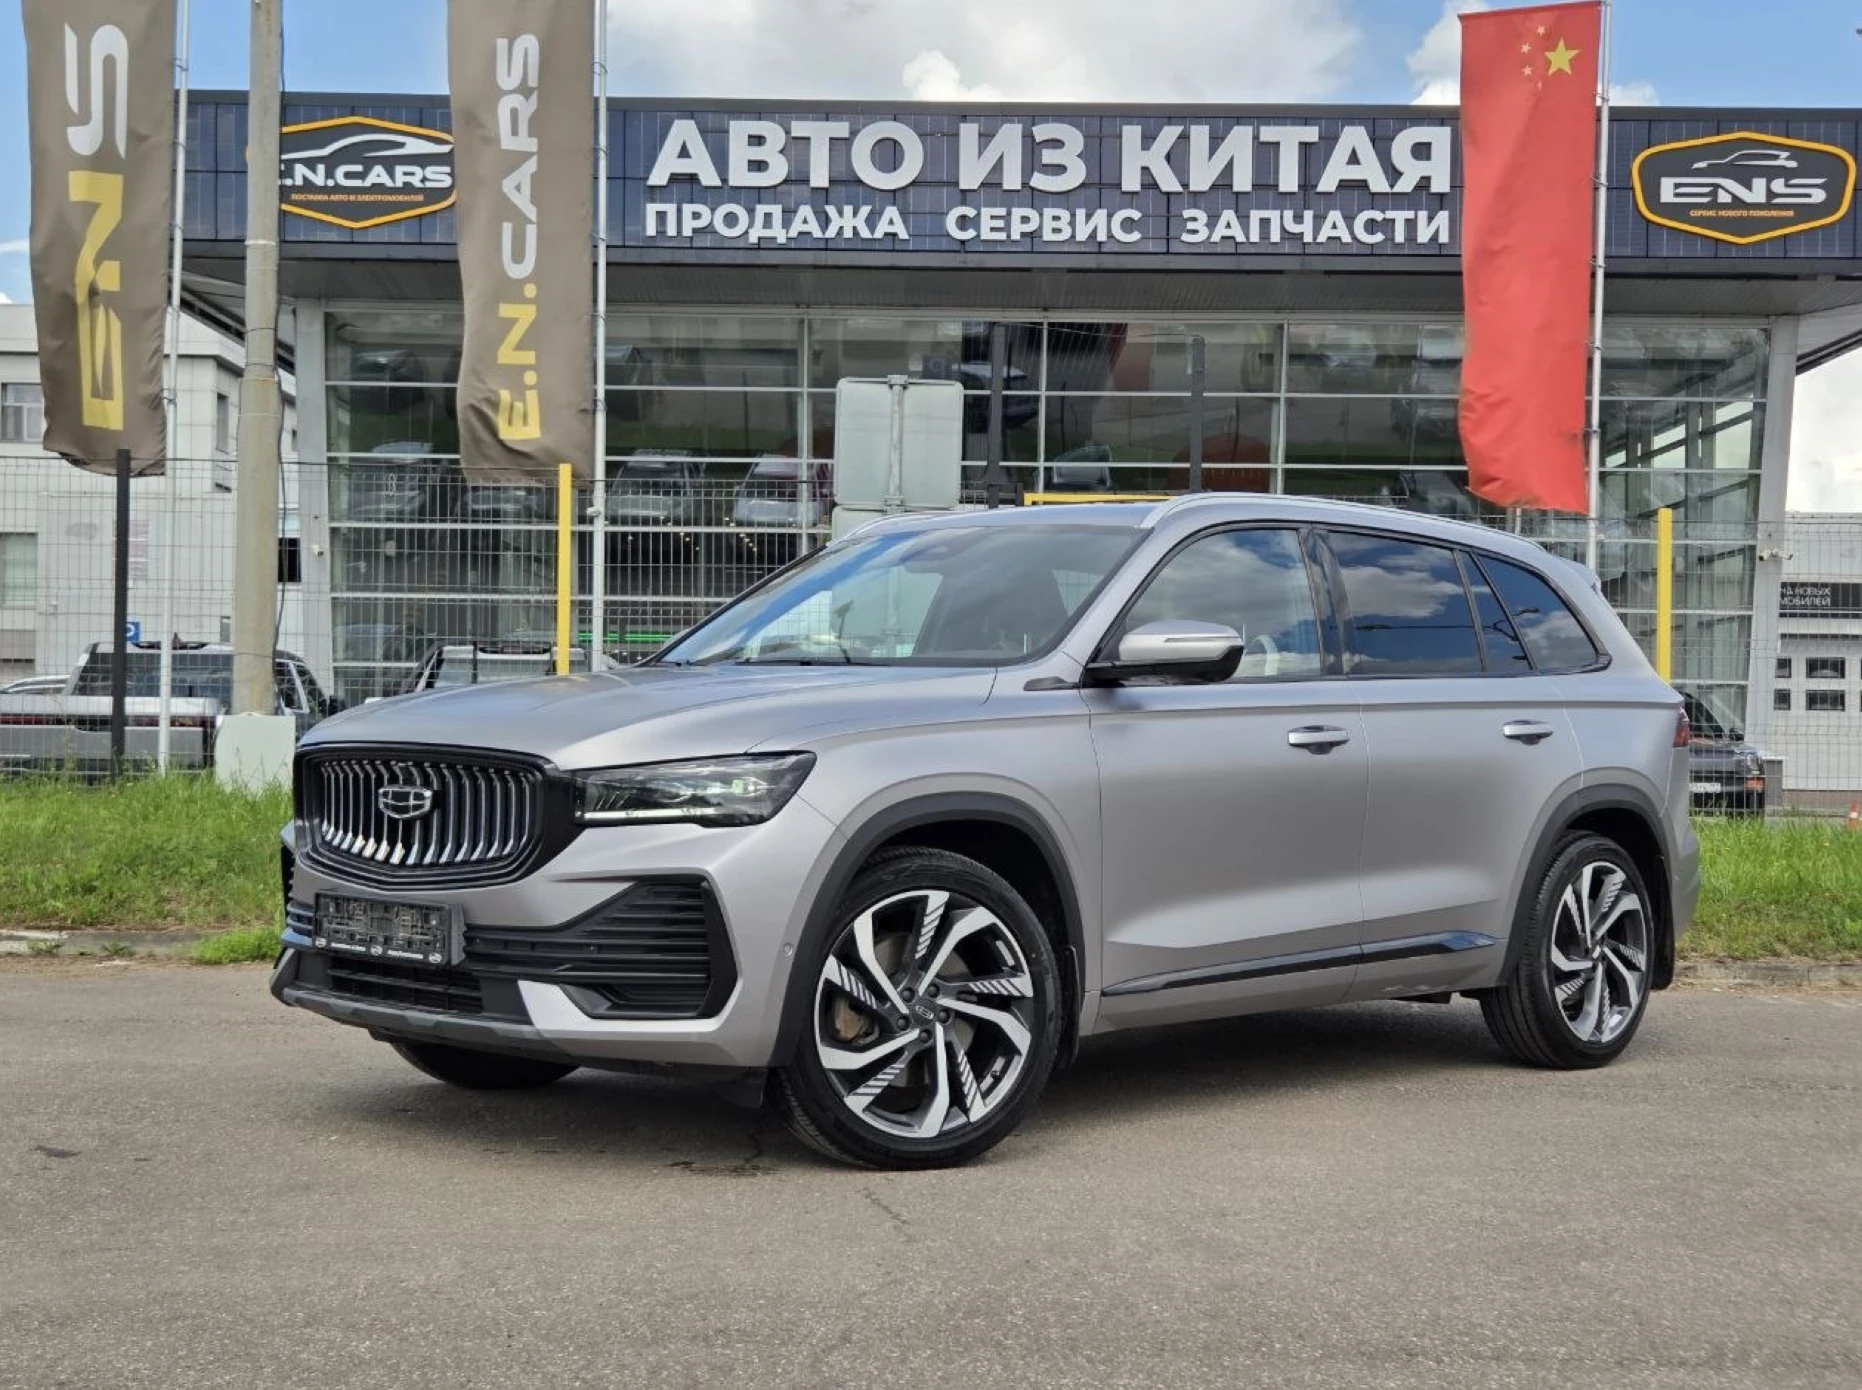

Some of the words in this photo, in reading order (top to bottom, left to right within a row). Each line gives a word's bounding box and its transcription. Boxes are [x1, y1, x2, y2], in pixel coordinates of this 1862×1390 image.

[278, 163, 453, 190] .N.CARS
[646, 119, 924, 191] АВТО
[959, 123, 1087, 193] ИЗ
[1121, 125, 1452, 194] КИТАЯ
[1660, 176, 1828, 205] ENS
[497, 34, 541, 440] E.N.CARS
[645, 203, 911, 245] ПРОДАЖА
[945, 206, 1143, 244] СЕРВИС
[1180, 208, 1452, 245] ЗАПЧАСТИ
